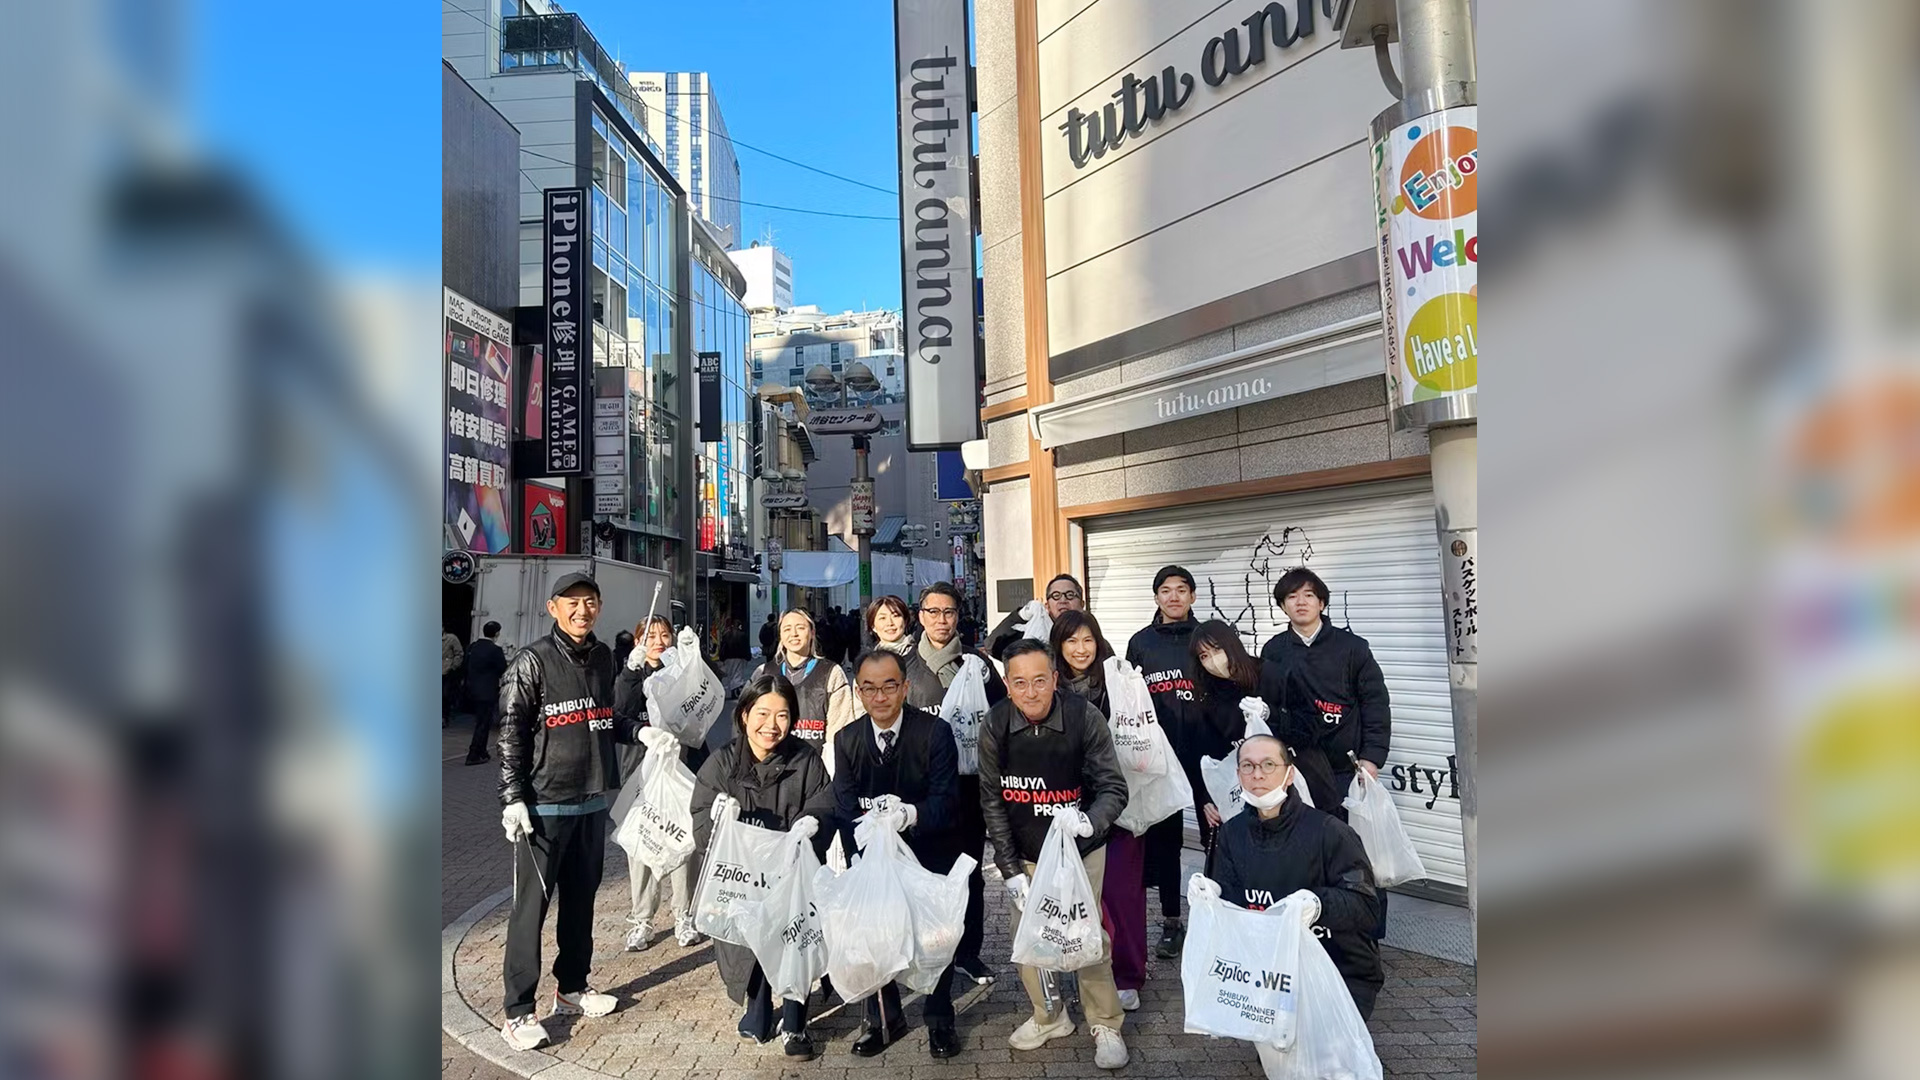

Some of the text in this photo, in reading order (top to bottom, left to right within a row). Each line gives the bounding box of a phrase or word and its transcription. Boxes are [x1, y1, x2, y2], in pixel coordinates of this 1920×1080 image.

[1058, 65, 1194, 166] tutu
[911, 46, 958, 364] tutu anna
[449, 296, 465, 312] MAC
[471, 308, 492, 326] iPhone
[466, 316, 490, 334] Android
[492, 328, 510, 345] GAME
[701, 357, 719, 367] ABC
[1410, 335, 1454, 378] Have
[1454, 334, 1468, 363] a
[450, 361, 507, 409] 即日修理
[1154, 377, 1272, 419] tutu anna
[449, 406, 507, 450] 格安販売
[551, 387, 562, 457] Android
[563, 385, 577, 451] GAME
[449, 452, 507, 490] 高額買取
[1453, 608, 1465, 657] ストリート
[544, 697, 596, 716] SHIBUYA
[546, 711, 586, 729] GOOD
[1000, 775, 1047, 790] HIBUYA
[1002, 785, 1082, 803] OOD MANNE
[713, 864, 751, 883] Ziploc
[718, 888, 747, 900] SHIBUYA
[1214, 960, 1292, 993] Ziploc .WE
[1217, 996, 1276, 1017] GOOD MANNER
[1240, 1010, 1275, 1025] PROJECT
